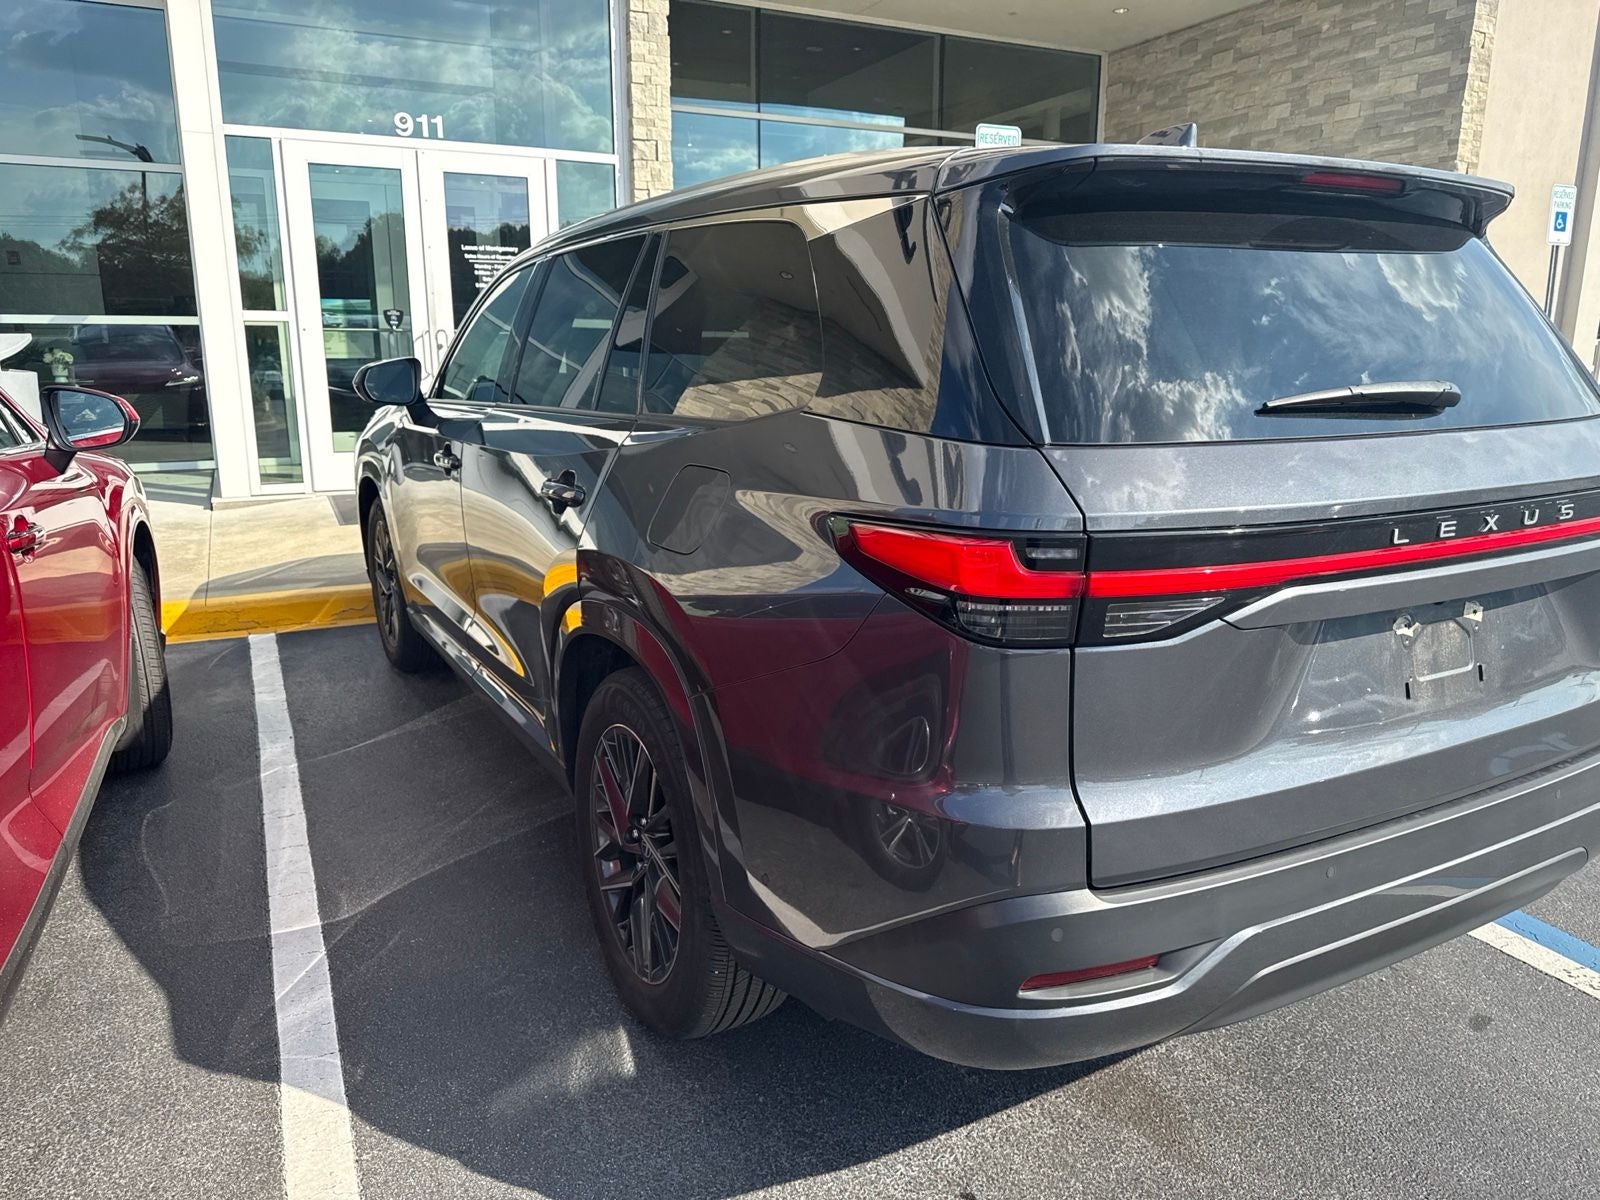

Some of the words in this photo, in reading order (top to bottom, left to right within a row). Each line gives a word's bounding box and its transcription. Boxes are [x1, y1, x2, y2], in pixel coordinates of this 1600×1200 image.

[394, 111, 444, 138] 911
[979, 132, 1018, 145] RESERVED
[1393, 504, 1575, 544] LEXUS
